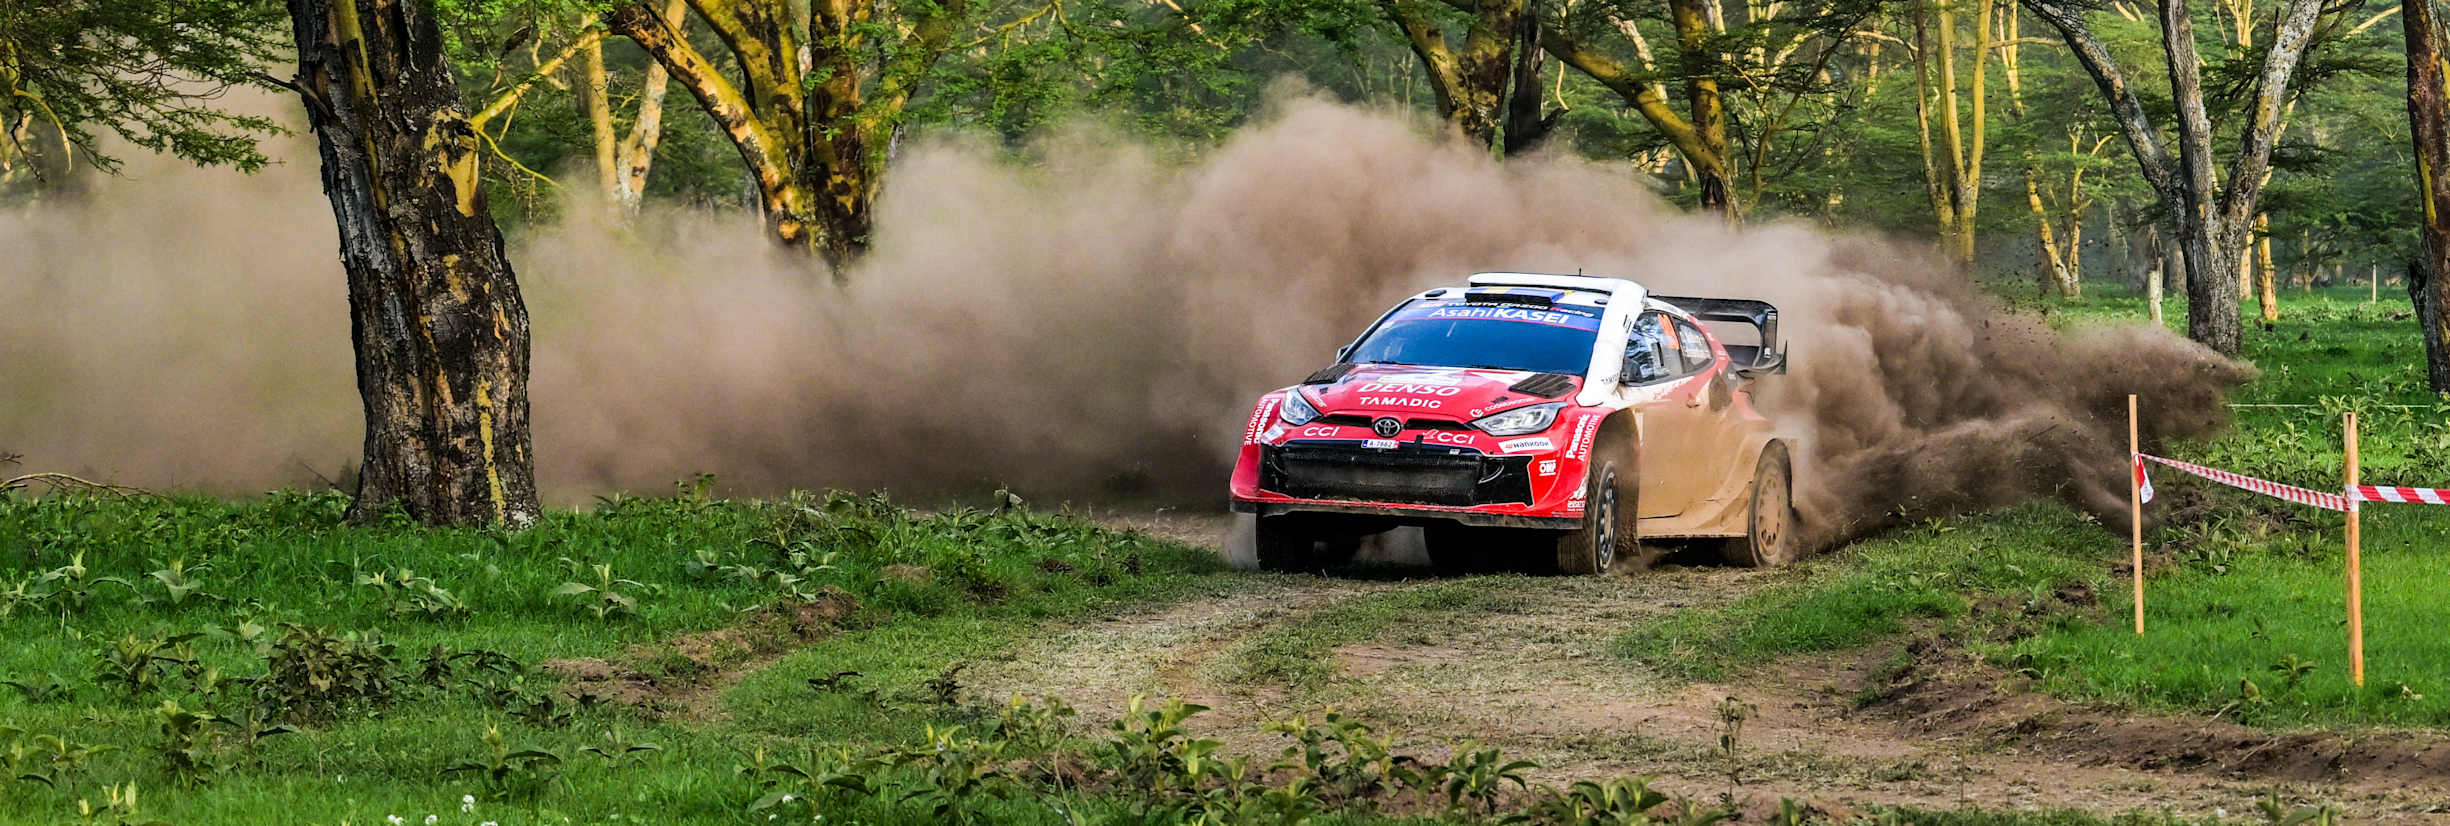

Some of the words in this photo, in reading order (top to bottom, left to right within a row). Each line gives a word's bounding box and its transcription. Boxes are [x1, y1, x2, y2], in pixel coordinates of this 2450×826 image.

[1357, 383, 1461, 396] DENSO
[1360, 397, 1441, 409] TAMADIC
[1303, 426, 1340, 437] CCI
[1565, 414, 1590, 459] Panasonic
[1437, 432, 1475, 445] CCI
[1513, 440, 1549, 449] Hankook
[1539, 462, 1556, 473] OMP
